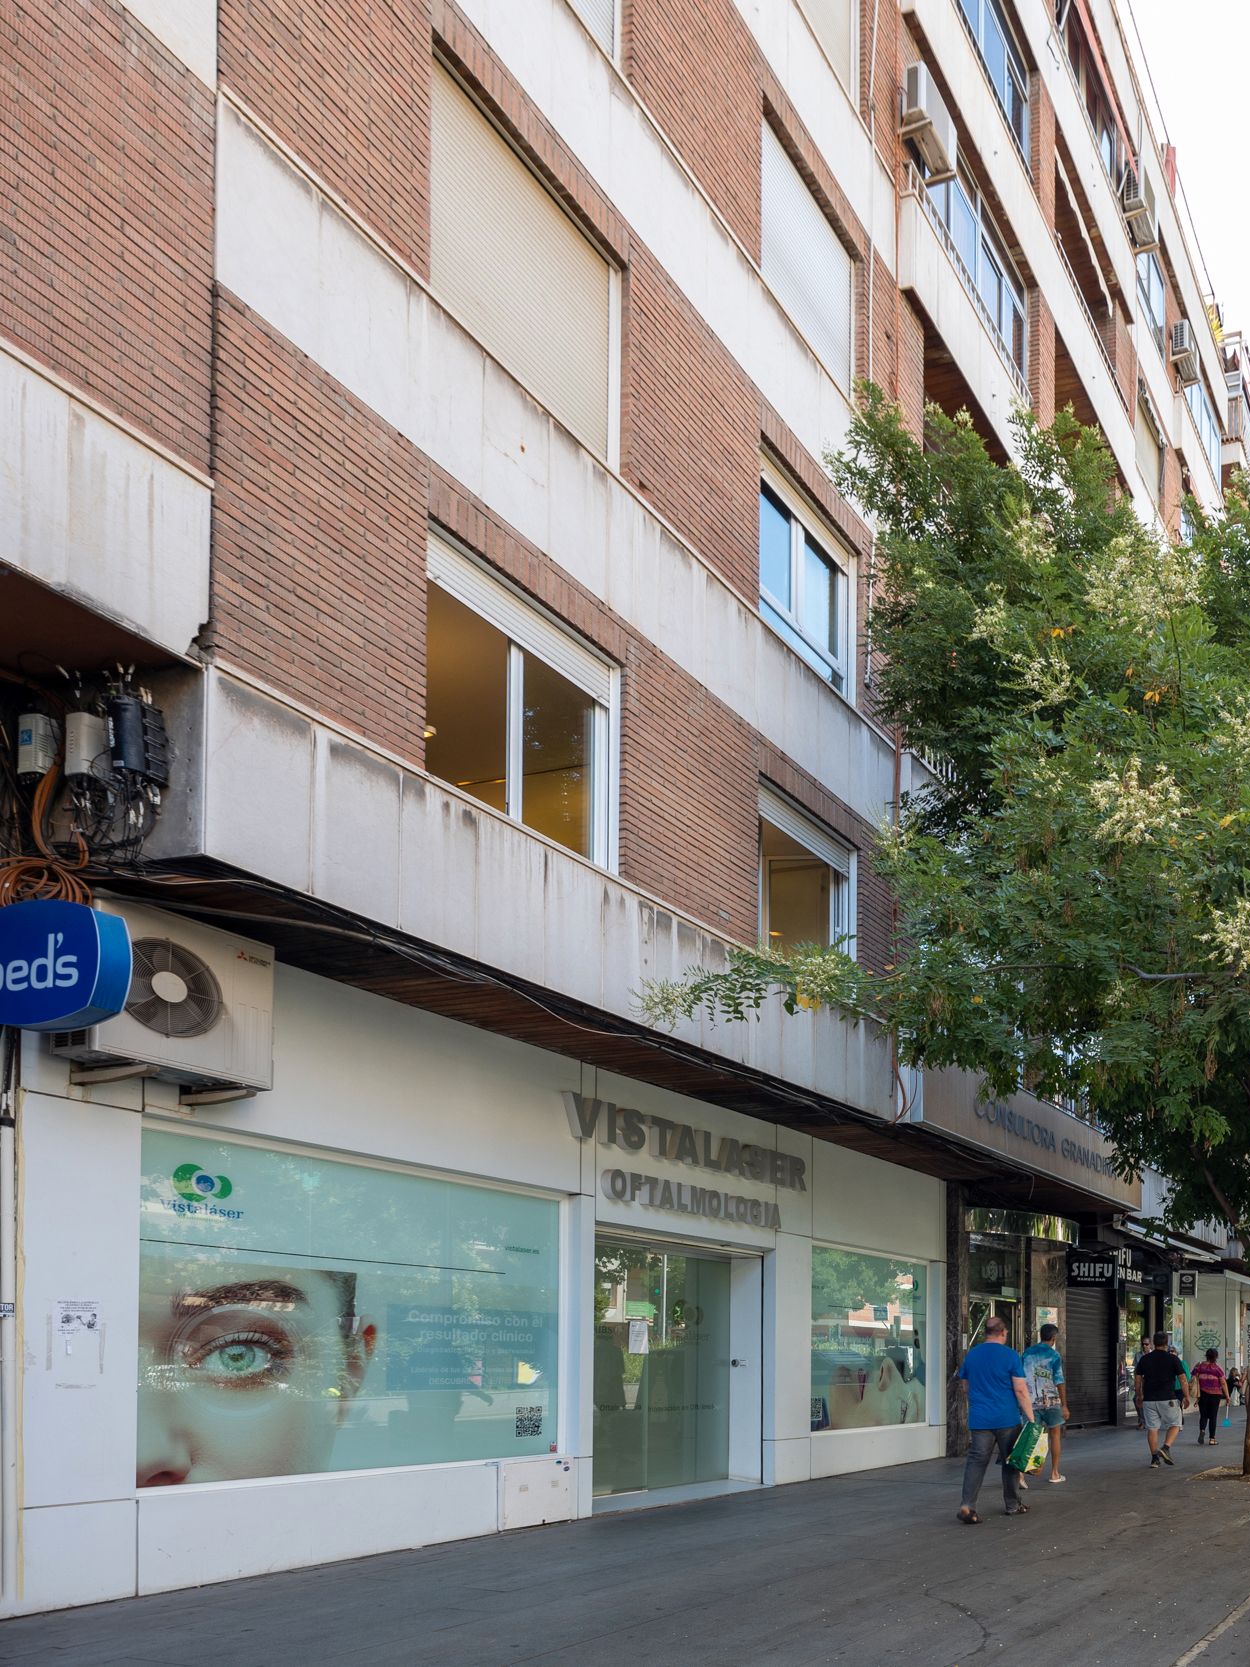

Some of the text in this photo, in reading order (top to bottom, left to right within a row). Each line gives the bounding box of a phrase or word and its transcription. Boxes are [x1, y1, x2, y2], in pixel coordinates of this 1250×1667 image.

[561, 1091, 807, 1192] VISTALASER
[975, 1097, 1057, 1153] CONSULTORA
[601, 1168, 782, 1229] OFTALMOLOGIA
[1071, 1262, 1113, 1278] SHIFU
[409, 1309, 501, 1327] Compromiso
[504, 1315, 528, 1327] con
[420, 1328, 488, 1342] resultado
